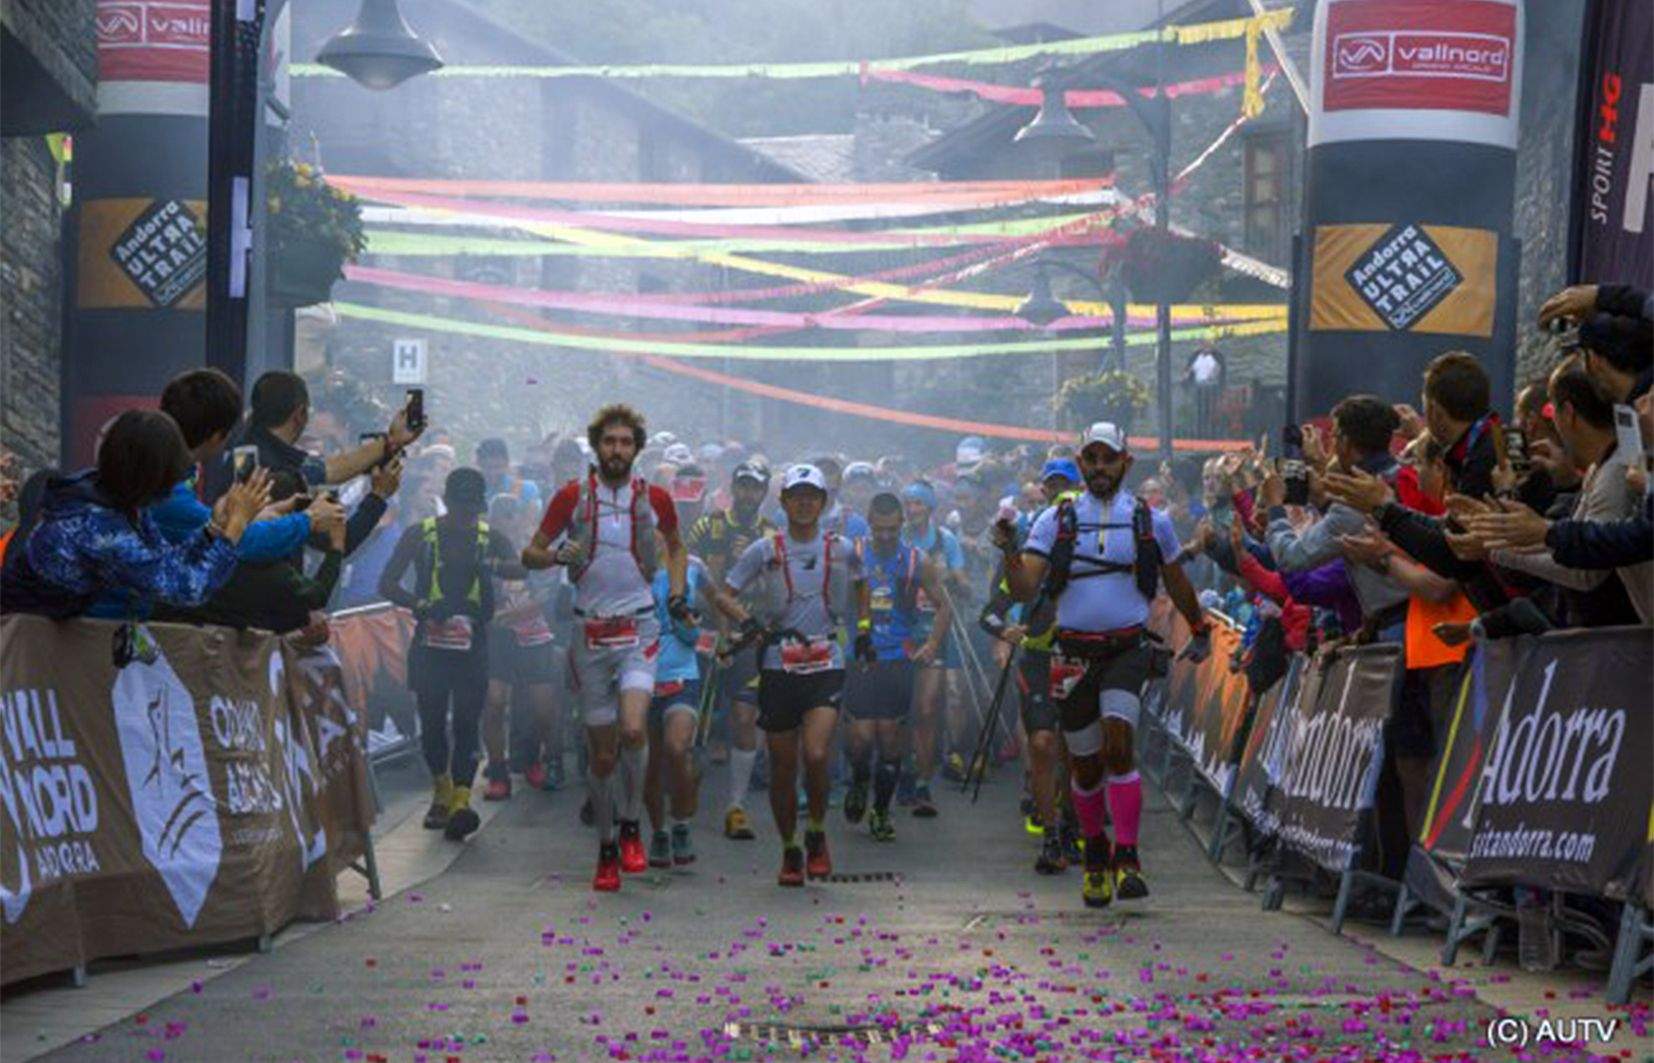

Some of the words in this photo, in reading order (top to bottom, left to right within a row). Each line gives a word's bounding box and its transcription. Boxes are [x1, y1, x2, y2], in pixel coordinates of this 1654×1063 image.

[1398, 44, 1505, 65] vallnord
[1591, 147, 1613, 225] SPORT
[115, 201, 179, 262] Andorra
[1352, 226, 1417, 286] Andorra
[399, 345, 418, 369] H
